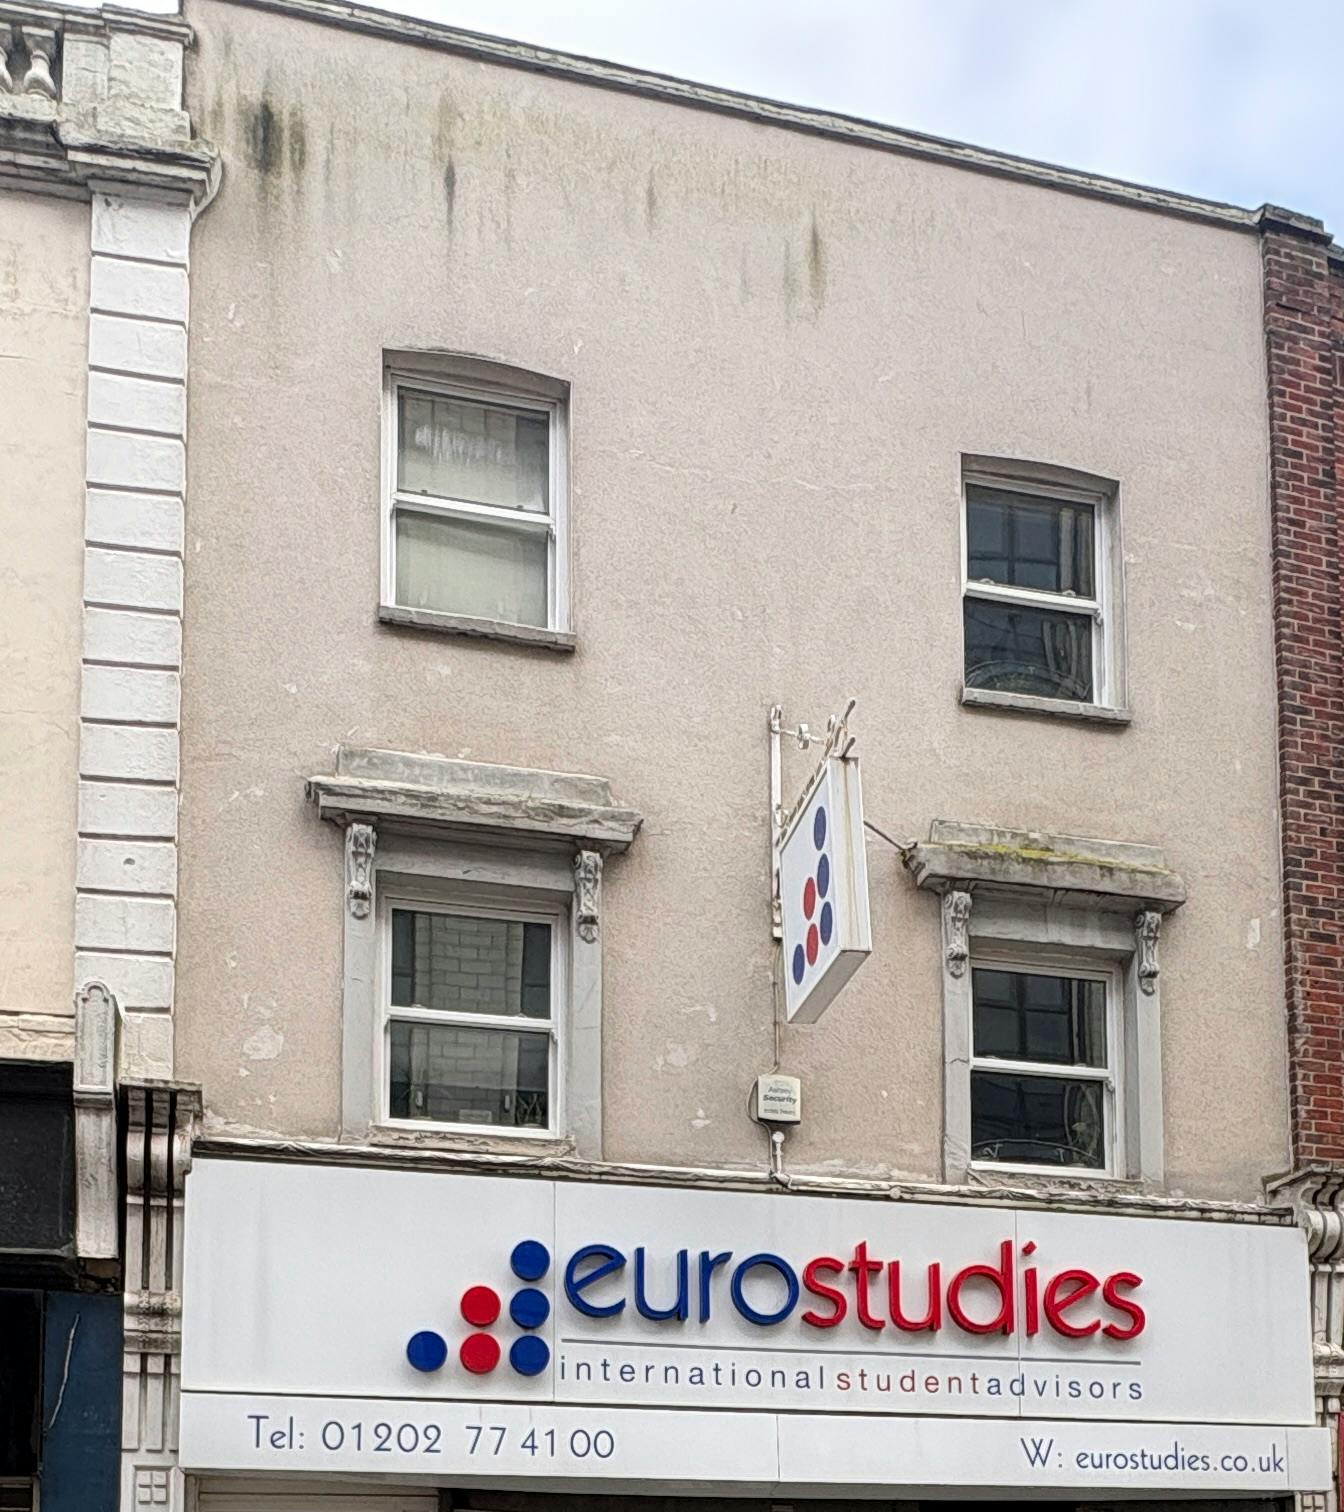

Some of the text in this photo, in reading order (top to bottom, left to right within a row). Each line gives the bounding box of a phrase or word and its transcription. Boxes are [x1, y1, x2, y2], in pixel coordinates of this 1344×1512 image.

[562, 1238, 1146, 1343] eurostudies
[247, 1414, 305, 1453] Tel:
[321, 1420, 443, 1456] 01202
[1019, 1436, 1285, 1474] W: eurostudies.co.uk
